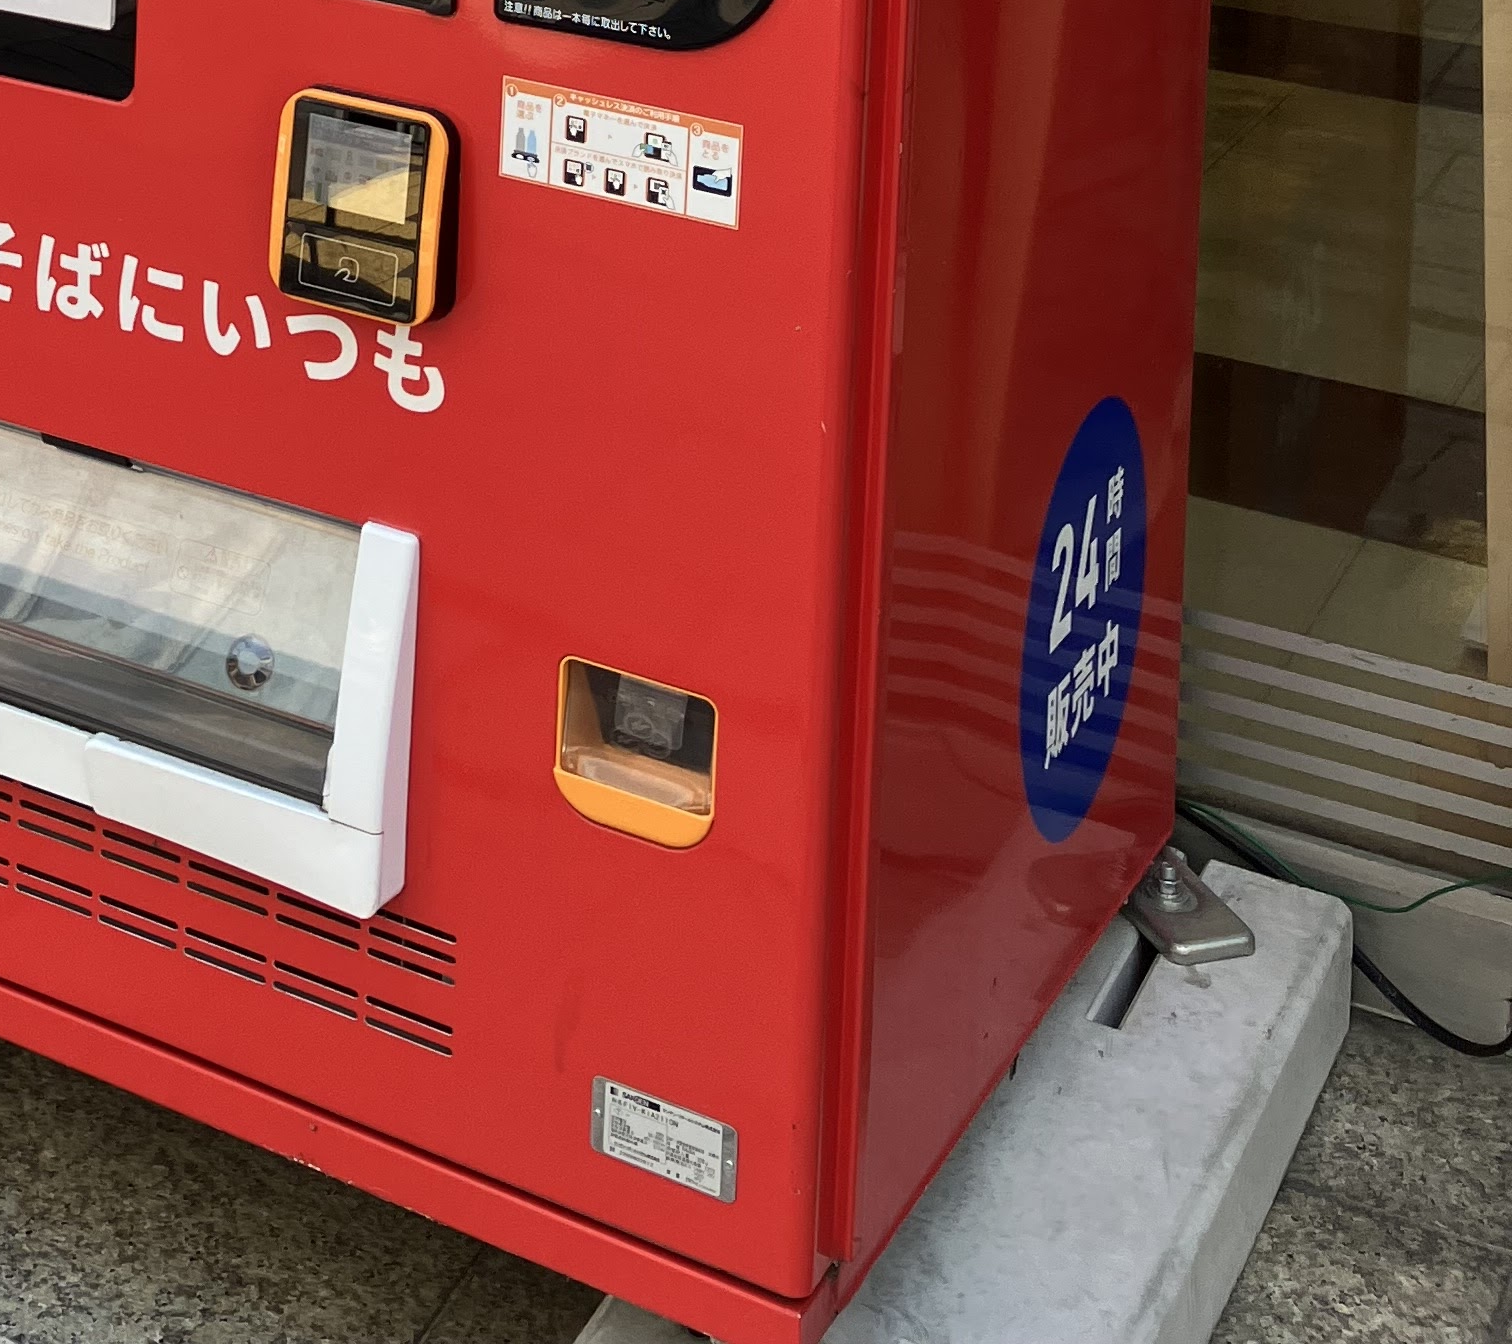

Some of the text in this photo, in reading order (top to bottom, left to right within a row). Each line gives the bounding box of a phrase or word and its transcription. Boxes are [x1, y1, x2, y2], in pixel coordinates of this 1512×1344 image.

[1049, 494, 1100, 654] 24
[1044, 619, 1119, 770] 販売中
